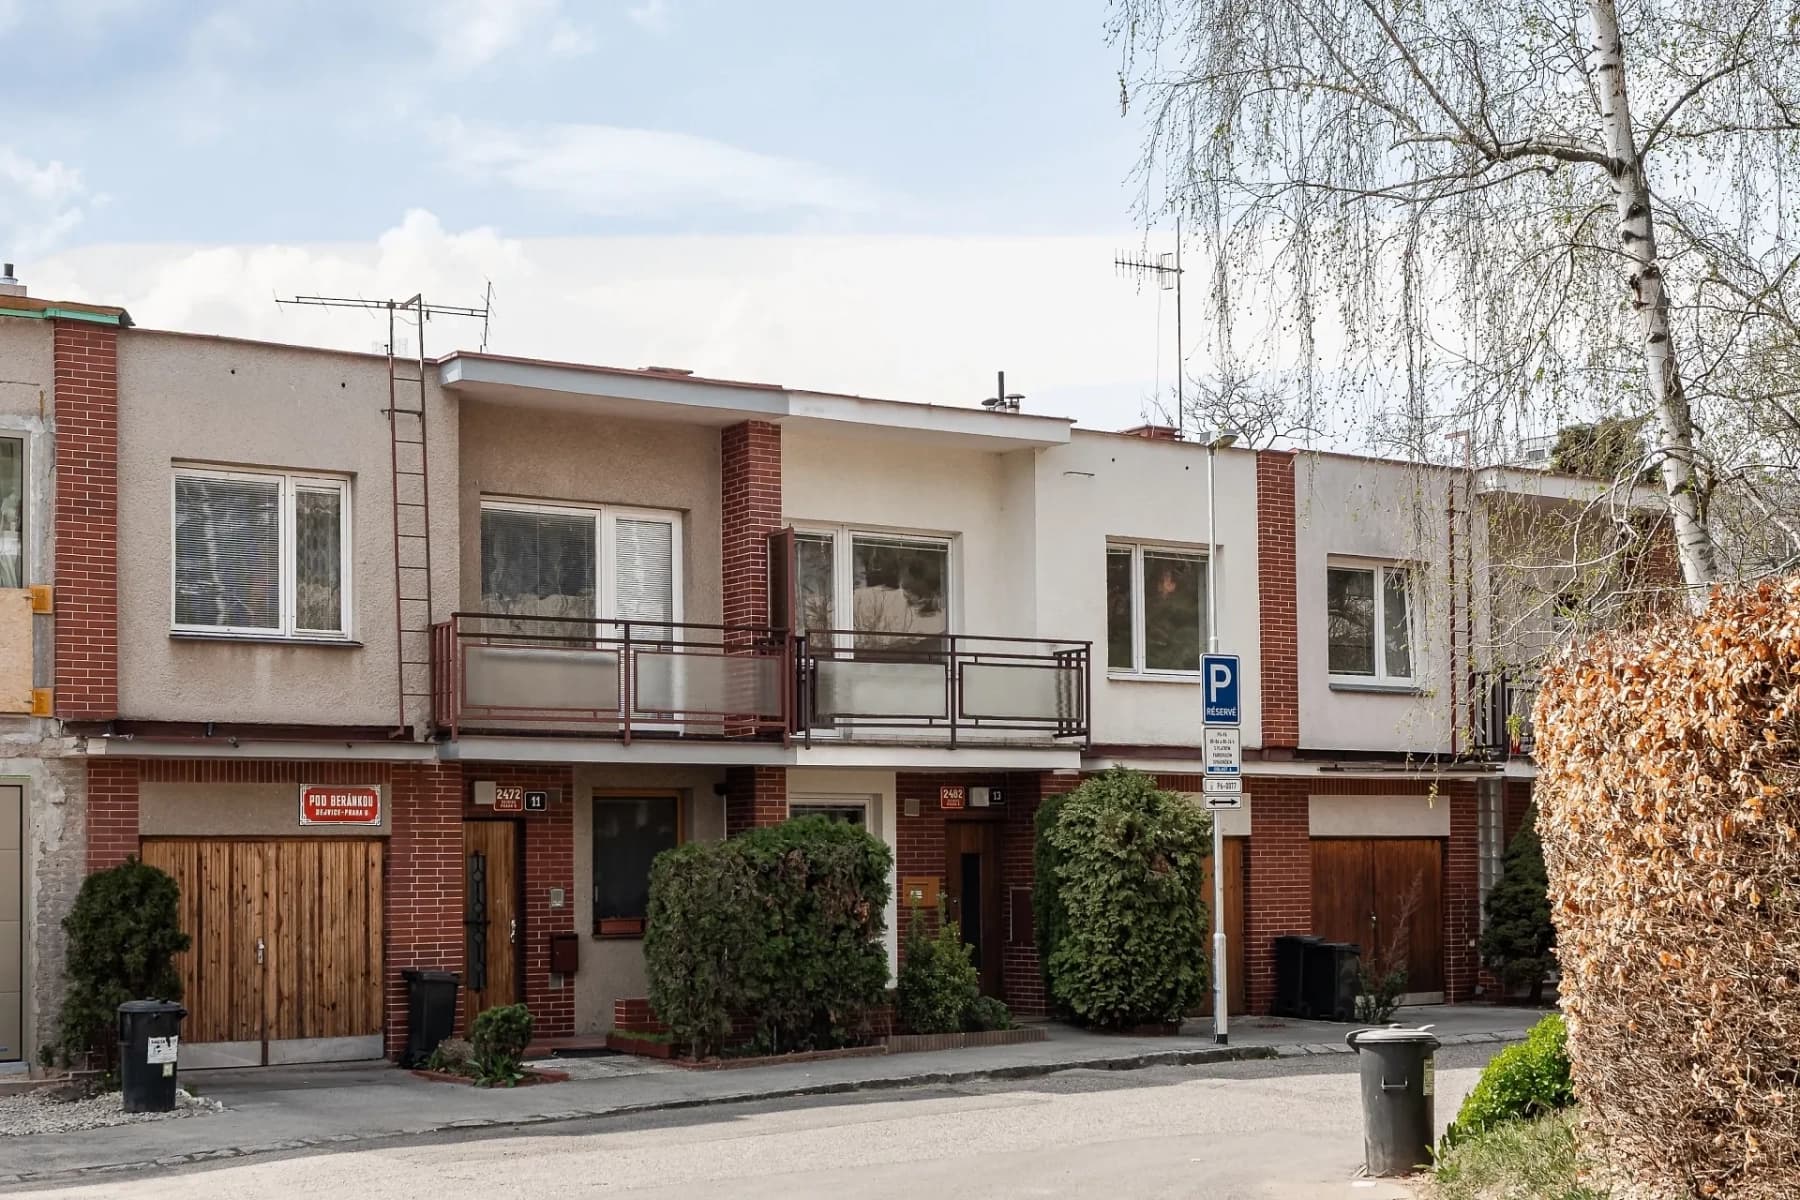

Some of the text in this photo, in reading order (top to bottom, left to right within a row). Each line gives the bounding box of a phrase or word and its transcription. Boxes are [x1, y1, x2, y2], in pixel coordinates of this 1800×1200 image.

[1210, 664, 1231, 703] P
[1206, 705, 1237, 716] RÉSERVÉ
[496, 788, 520, 800] 2472
[992, 791, 1001, 800] 13
[309, 793, 373, 807] POD BERÁNKOU
[531, 796, 541, 807] 11
